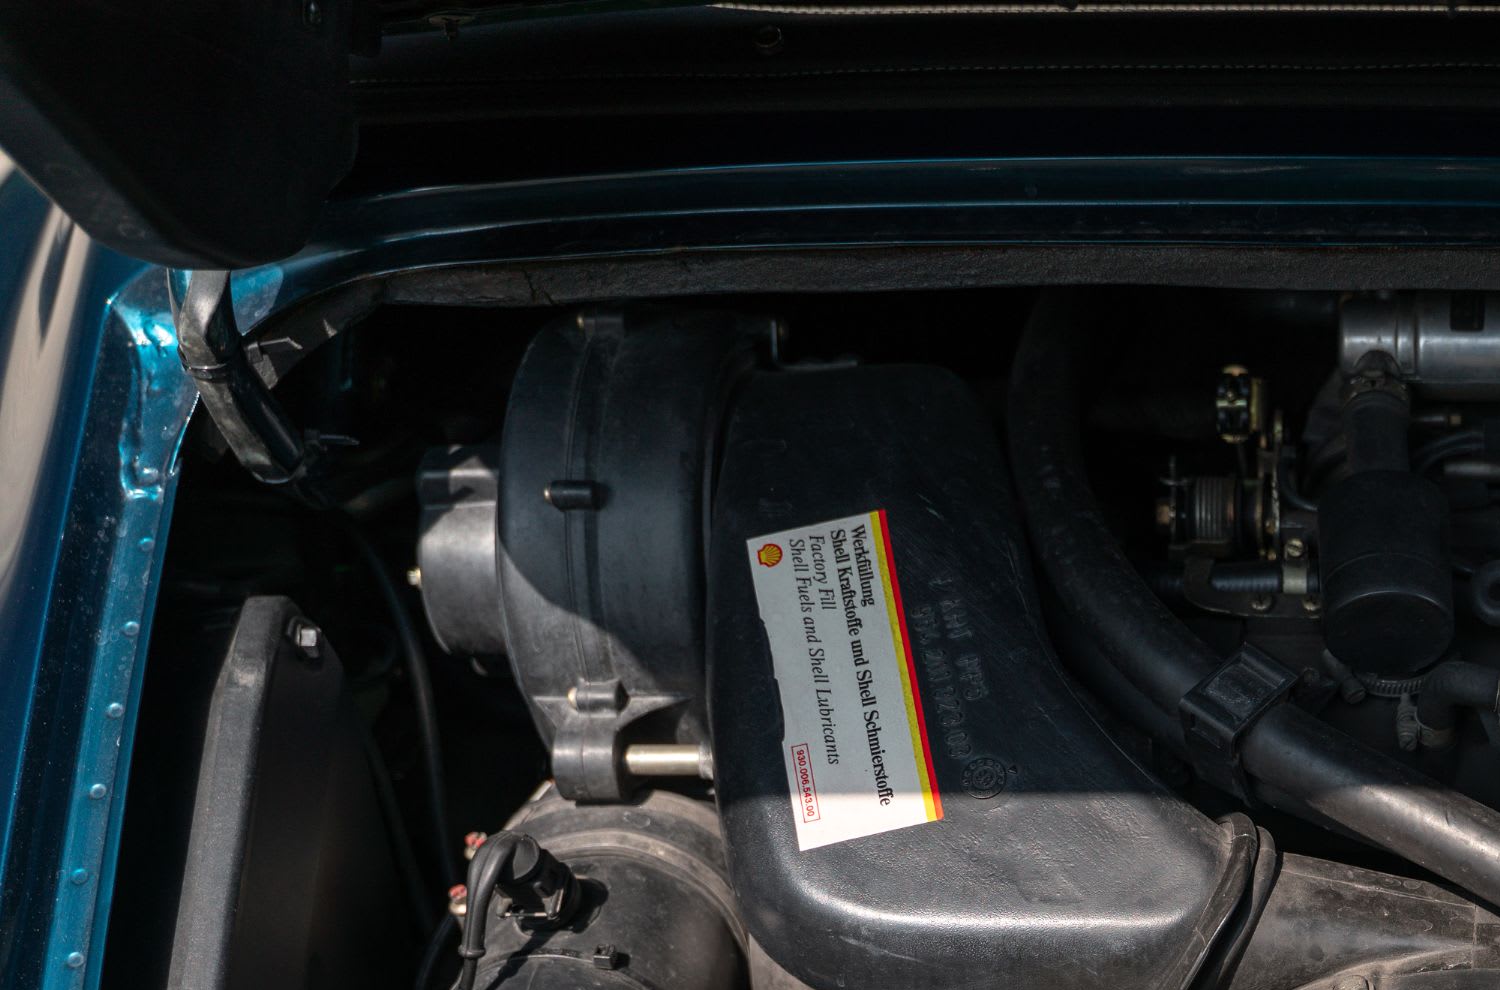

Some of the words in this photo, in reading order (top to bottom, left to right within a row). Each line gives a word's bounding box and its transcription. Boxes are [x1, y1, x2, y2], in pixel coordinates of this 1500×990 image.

[789, 536, 807, 573] Shell
[831, 527, 848, 564] Shell
[848, 523, 877, 607] Werkfüllung
[807, 532, 830, 585] Factory
[819, 585, 834, 612] Fill
[796, 573, 814, 613] Fuels
[837, 564, 861, 636] Kraftstoffe
[803, 614, 820, 645] and
[808, 645, 827, 685] Shell
[851, 637, 867, 667] und
[856, 668, 874, 707] Shell
[816, 686, 841, 765] Lubricants
[863, 709, 893, 807] Schmierstoffe
[795, 749, 815, 817] 930.006.543.00
